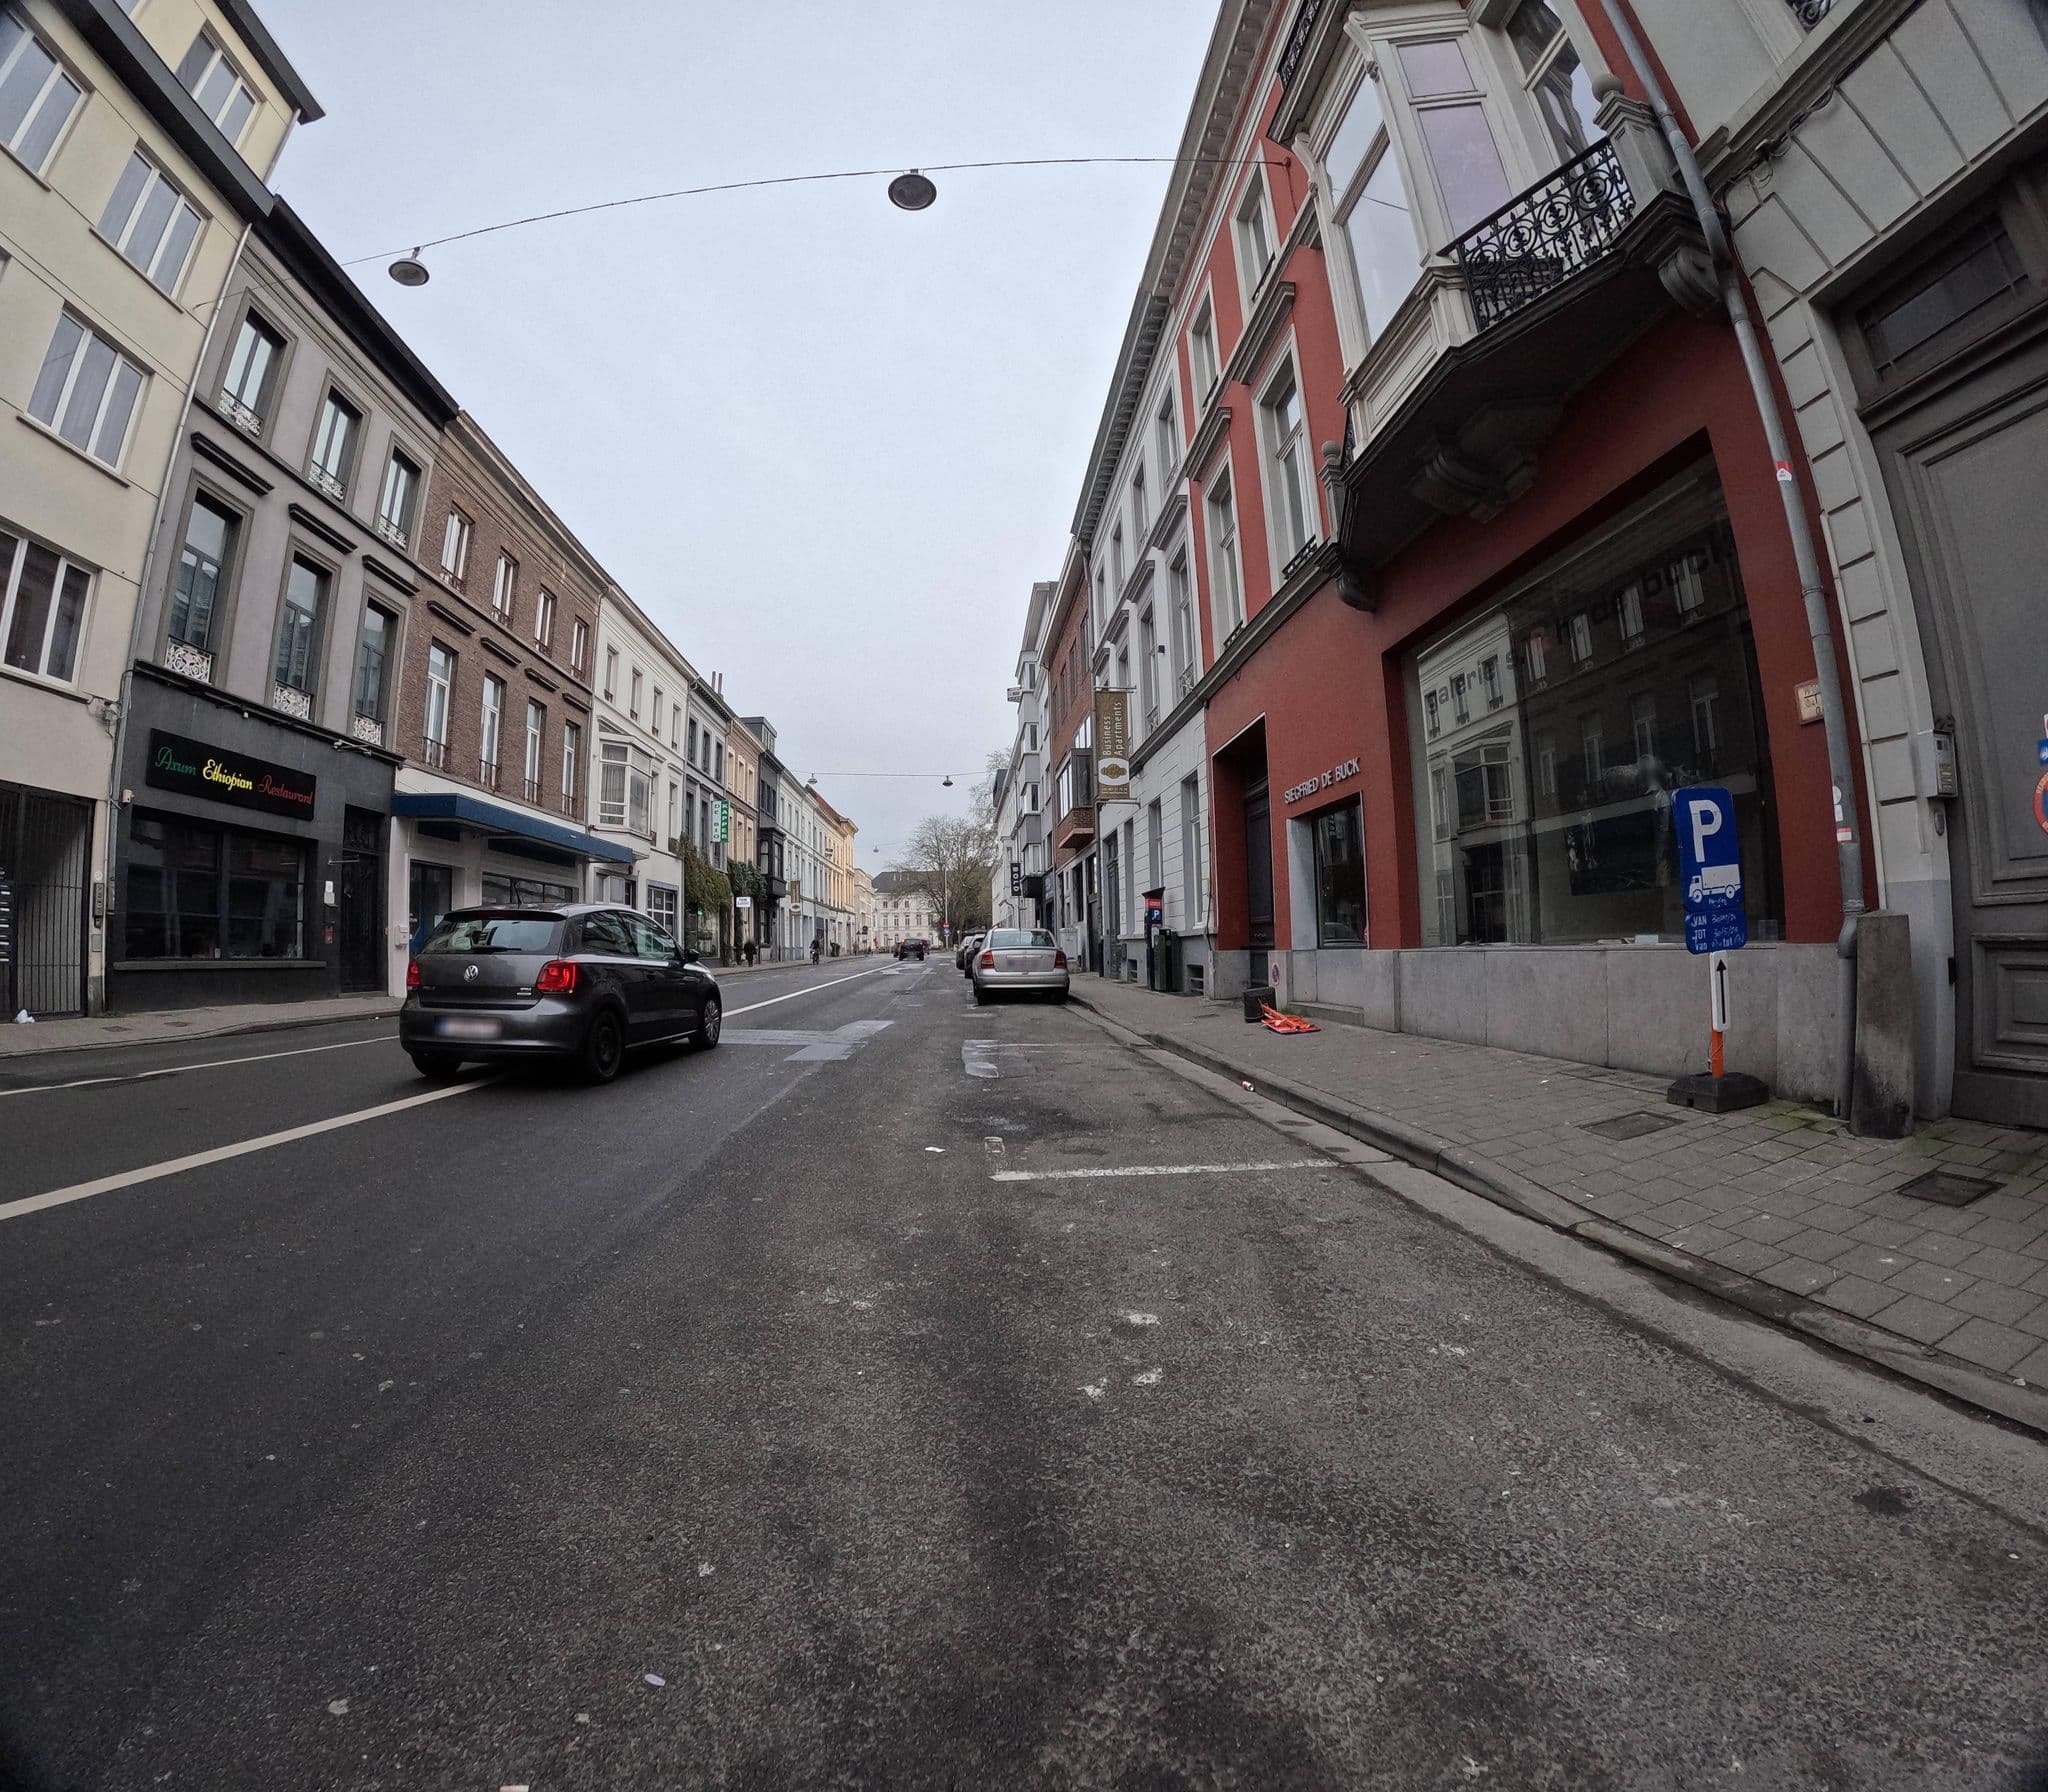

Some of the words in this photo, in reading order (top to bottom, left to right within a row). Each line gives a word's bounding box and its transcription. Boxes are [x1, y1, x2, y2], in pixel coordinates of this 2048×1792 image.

[1103, 715, 1112, 757] Business
[1113, 702, 1124, 757] Apartments
[155, 746, 197, 776] Axum
[202, 758, 253, 791] Ethiopian
[258, 773, 314, 805] Restaurant
[1284, 777, 1319, 804] SIEGFRIED
[1321, 769, 1334, 788] DE
[1335, 756, 1361, 782] BUCK
[1688, 799, 1722, 863] P
